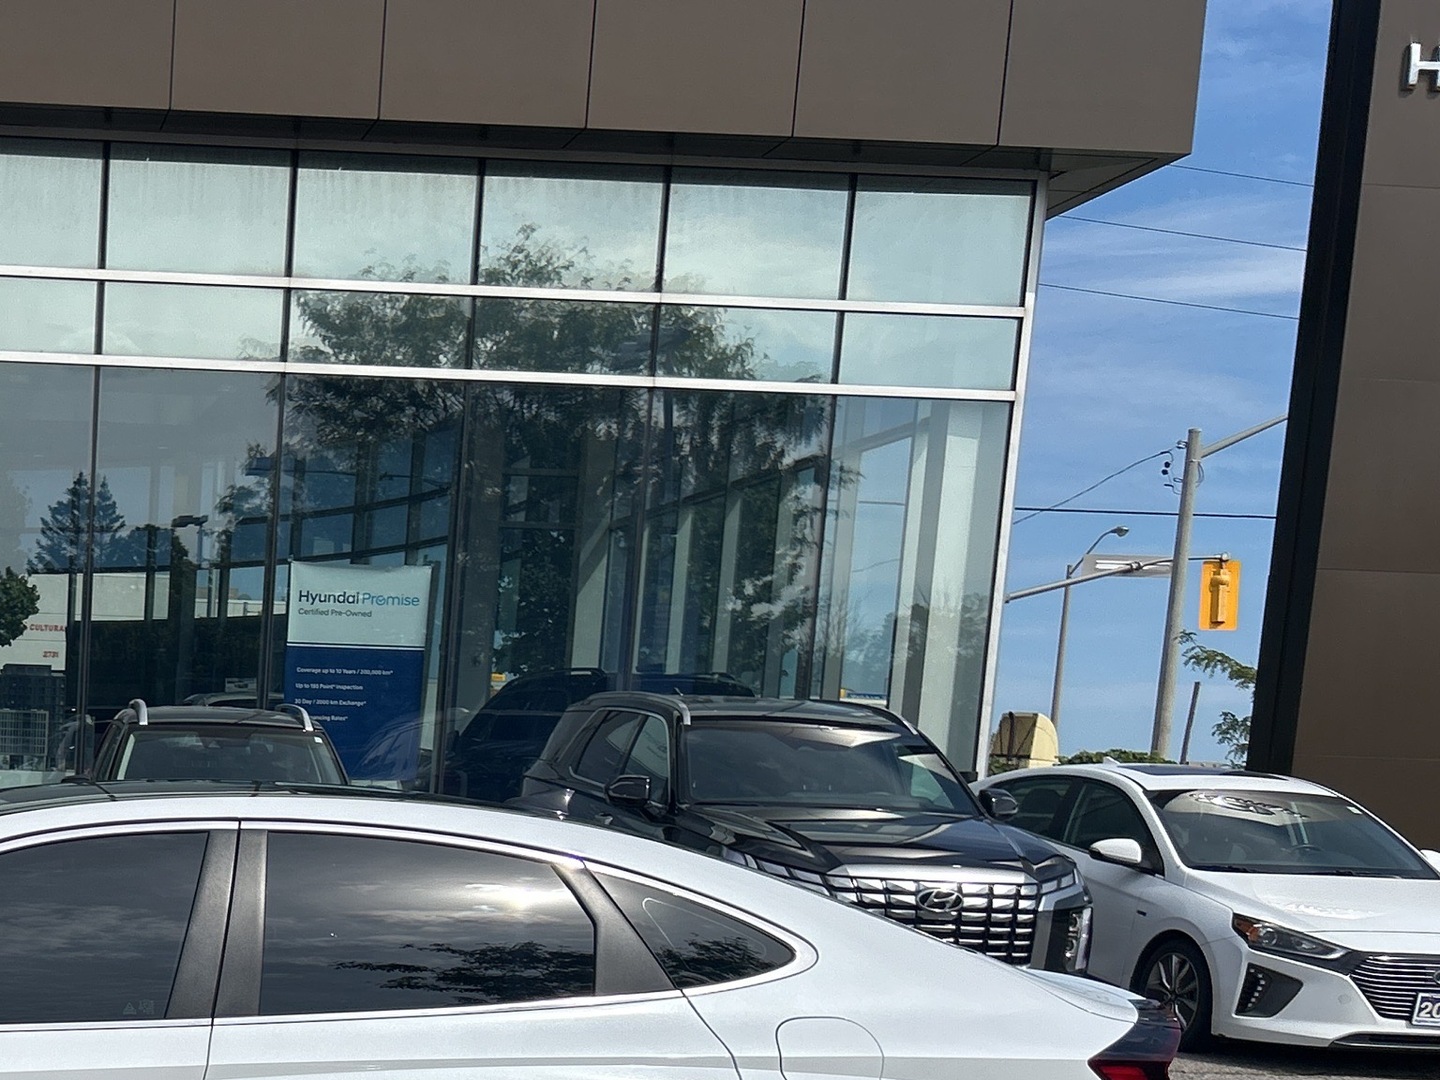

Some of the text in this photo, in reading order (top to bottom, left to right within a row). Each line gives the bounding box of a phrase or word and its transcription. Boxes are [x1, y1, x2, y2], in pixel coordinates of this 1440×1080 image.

[298, 590, 420, 606] Hyundai Promise
[298, 608, 372, 617] Certified Pre-Owned
